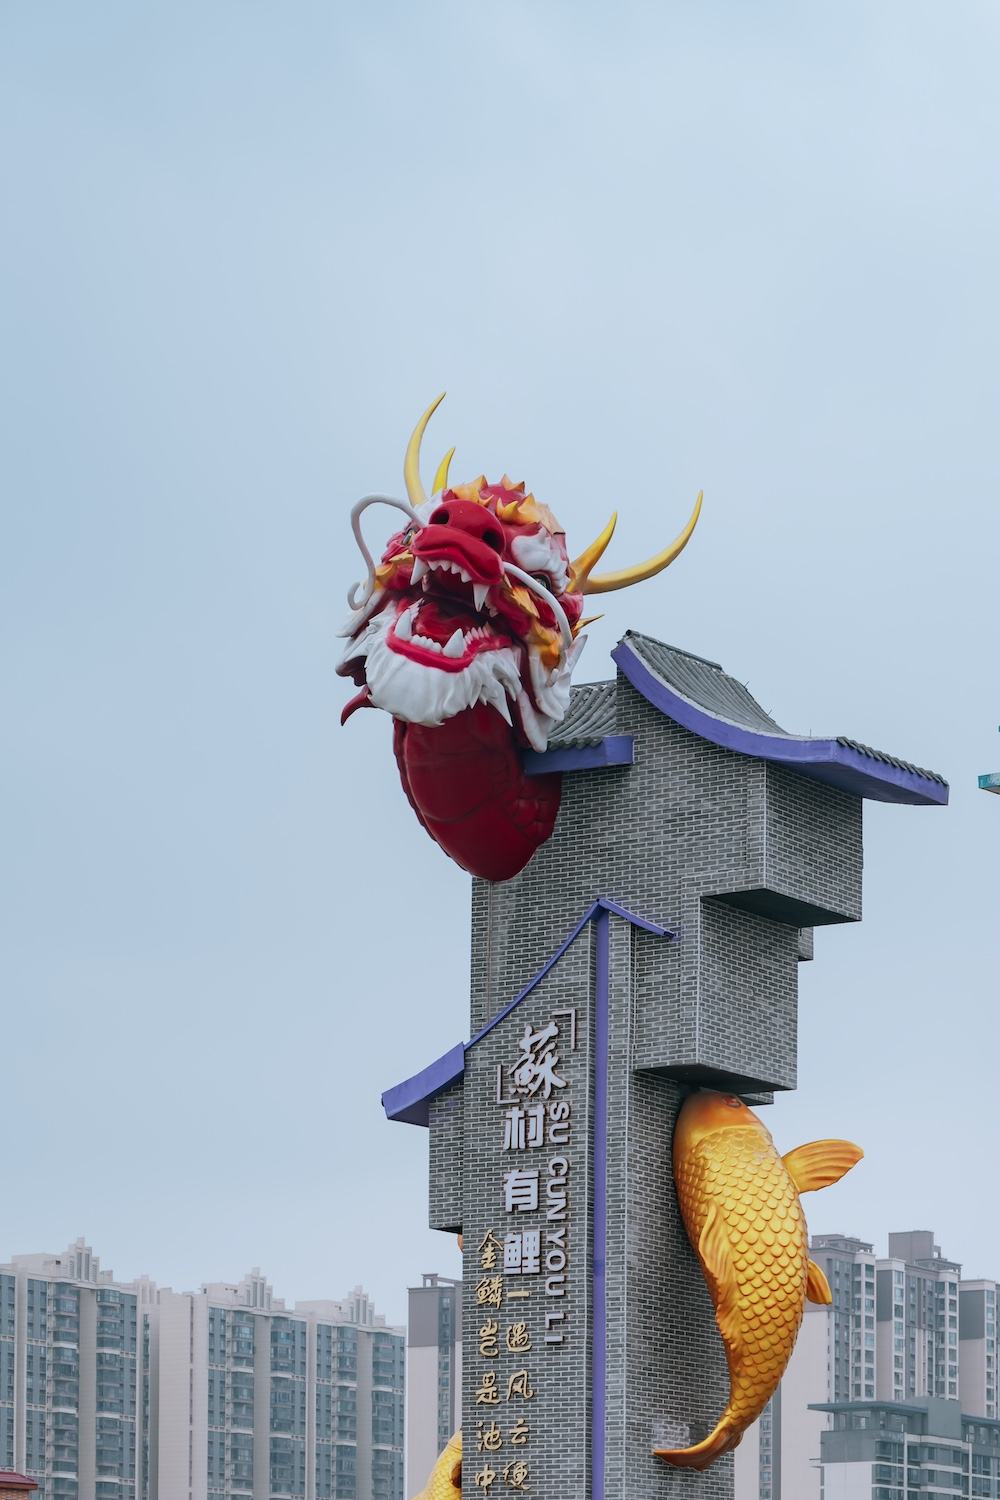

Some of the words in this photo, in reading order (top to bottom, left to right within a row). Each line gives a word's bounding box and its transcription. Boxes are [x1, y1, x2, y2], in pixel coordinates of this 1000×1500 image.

[549, 1101, 570, 1144] SU
[546, 1156, 569, 1221] CUN
[545, 1233, 567, 1297] YOU
[544, 1311, 566, 1343] LI
